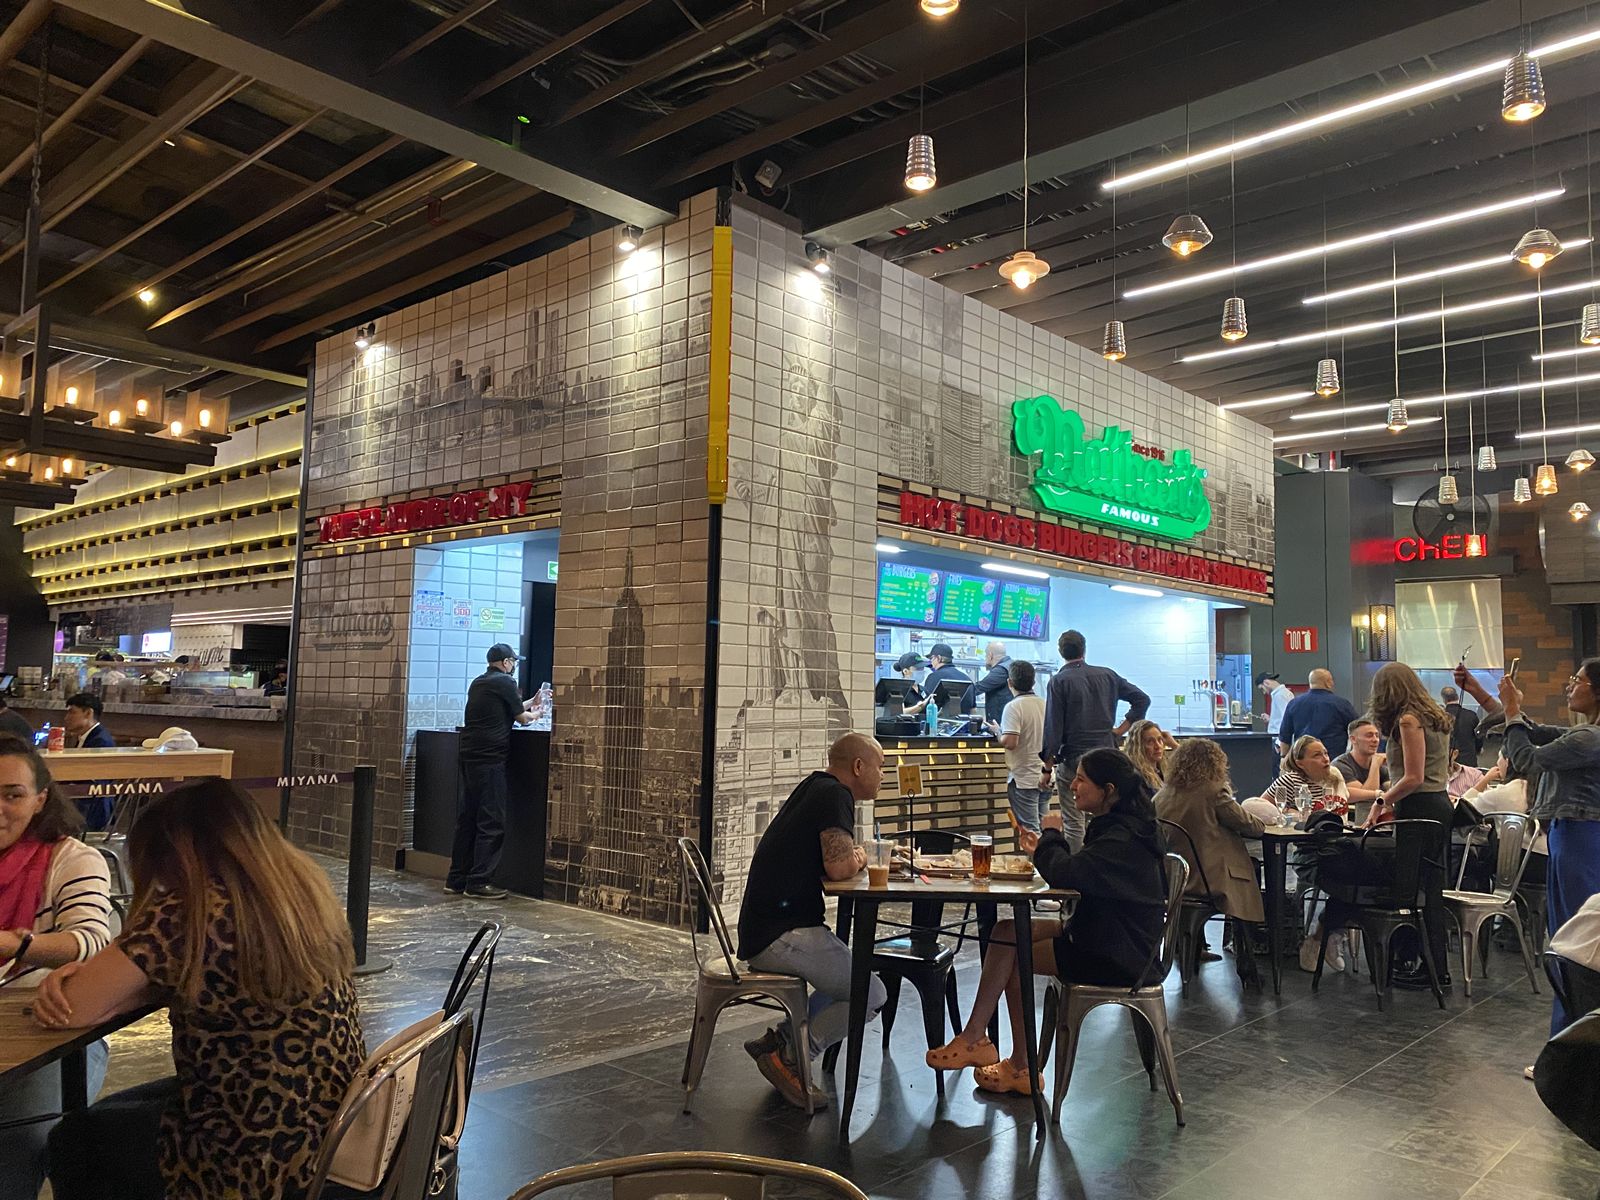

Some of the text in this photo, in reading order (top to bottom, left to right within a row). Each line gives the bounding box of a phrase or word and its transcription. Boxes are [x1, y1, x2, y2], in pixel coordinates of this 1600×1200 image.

[450, 490, 489, 525] OF
[488, 481, 534, 520] NY
[1101, 502, 1160, 527] FAMOUS
[900, 491, 1269, 594] HOT DOGS BURGERS CHICKEN SHAKES
[88, 782, 164, 796] MIYANA
[276, 773, 338, 787] MIYANA
